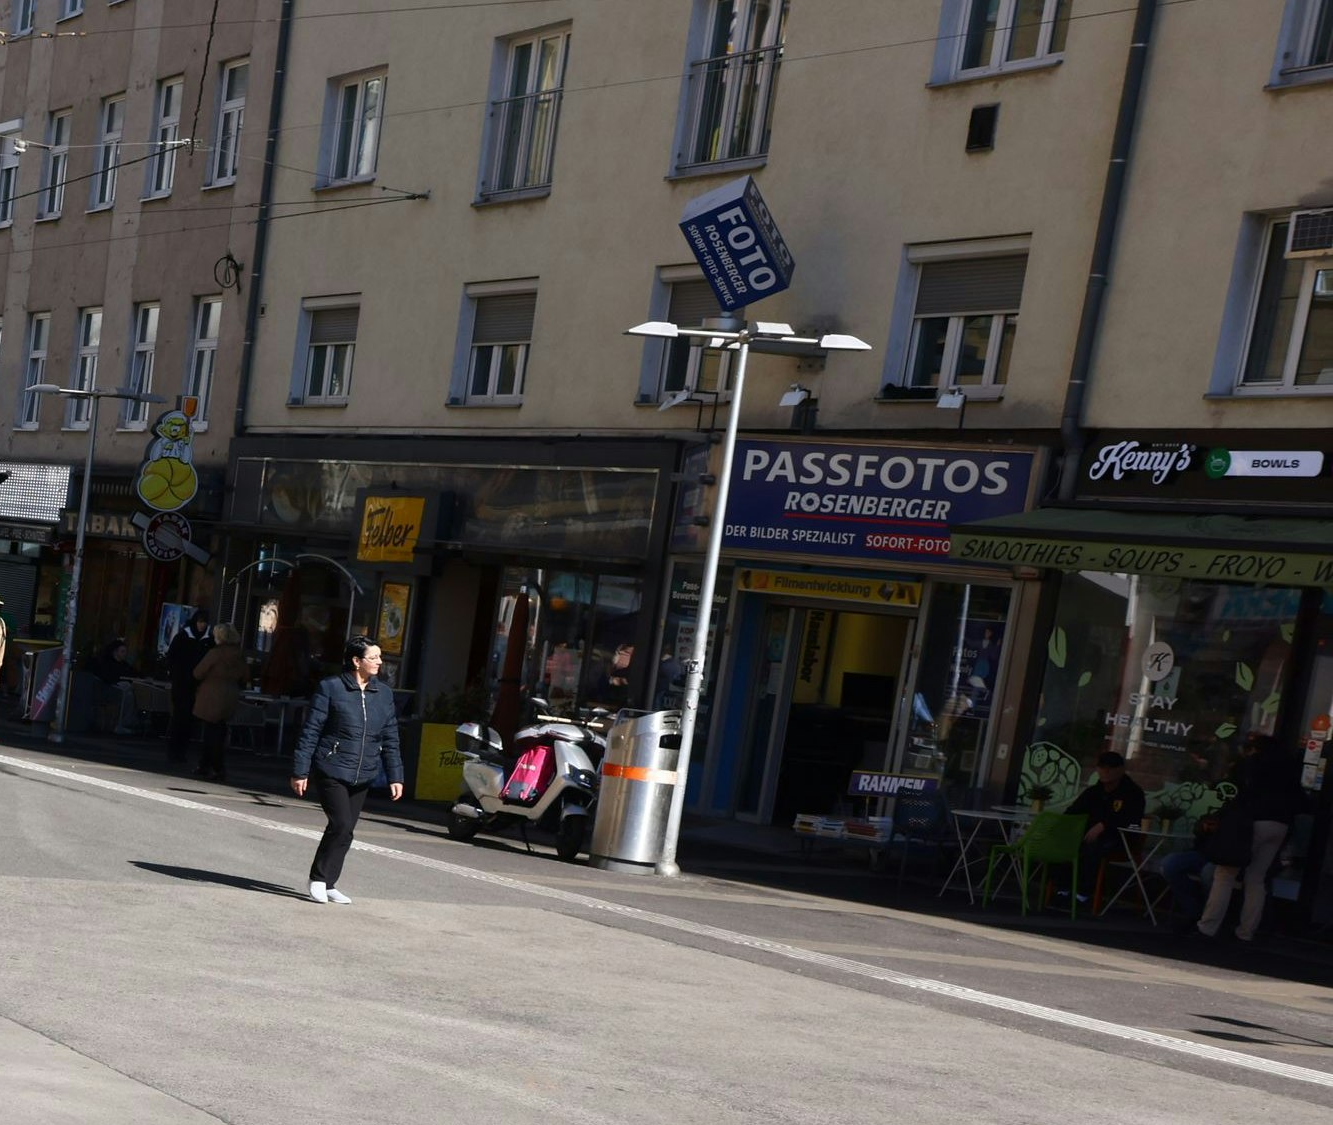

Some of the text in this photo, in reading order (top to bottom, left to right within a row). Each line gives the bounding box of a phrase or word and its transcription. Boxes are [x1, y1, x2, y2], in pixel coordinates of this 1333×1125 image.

[705, 224, 748, 294] ROSENBERGER
[717, 206, 776, 291] FOTO
[688, 224, 736, 307] SOFORT-FOTO-SERVICE
[742, 449, 1011, 496] PASSFOTOS
[1089, 440, 1193, 485] Kenny's
[1251, 459, 1300, 469] BOWLS
[784, 491, 952, 521] ROSENBERGER
[365, 506, 414, 548] Felber
[725, 525, 747, 537] DER
[750, 527, 789, 541] BILDER
[792, 529, 856, 545] SPEZIALIST
[961, 538, 1083, 566] SMOOTHIES
[1103, 547, 1185, 573] SOUPS
[1206, 554, 1287, 580] FROYO
[774, 576, 872, 597] Filmentwicklung
[952, 646, 979, 658] Ftos
[1129, 692, 1179, 710] STAY
[1105, 712, 1194, 737] HEALTHY
[439, 750, 464, 768] Felbe
[858, 774, 926, 793] RAHMEN
